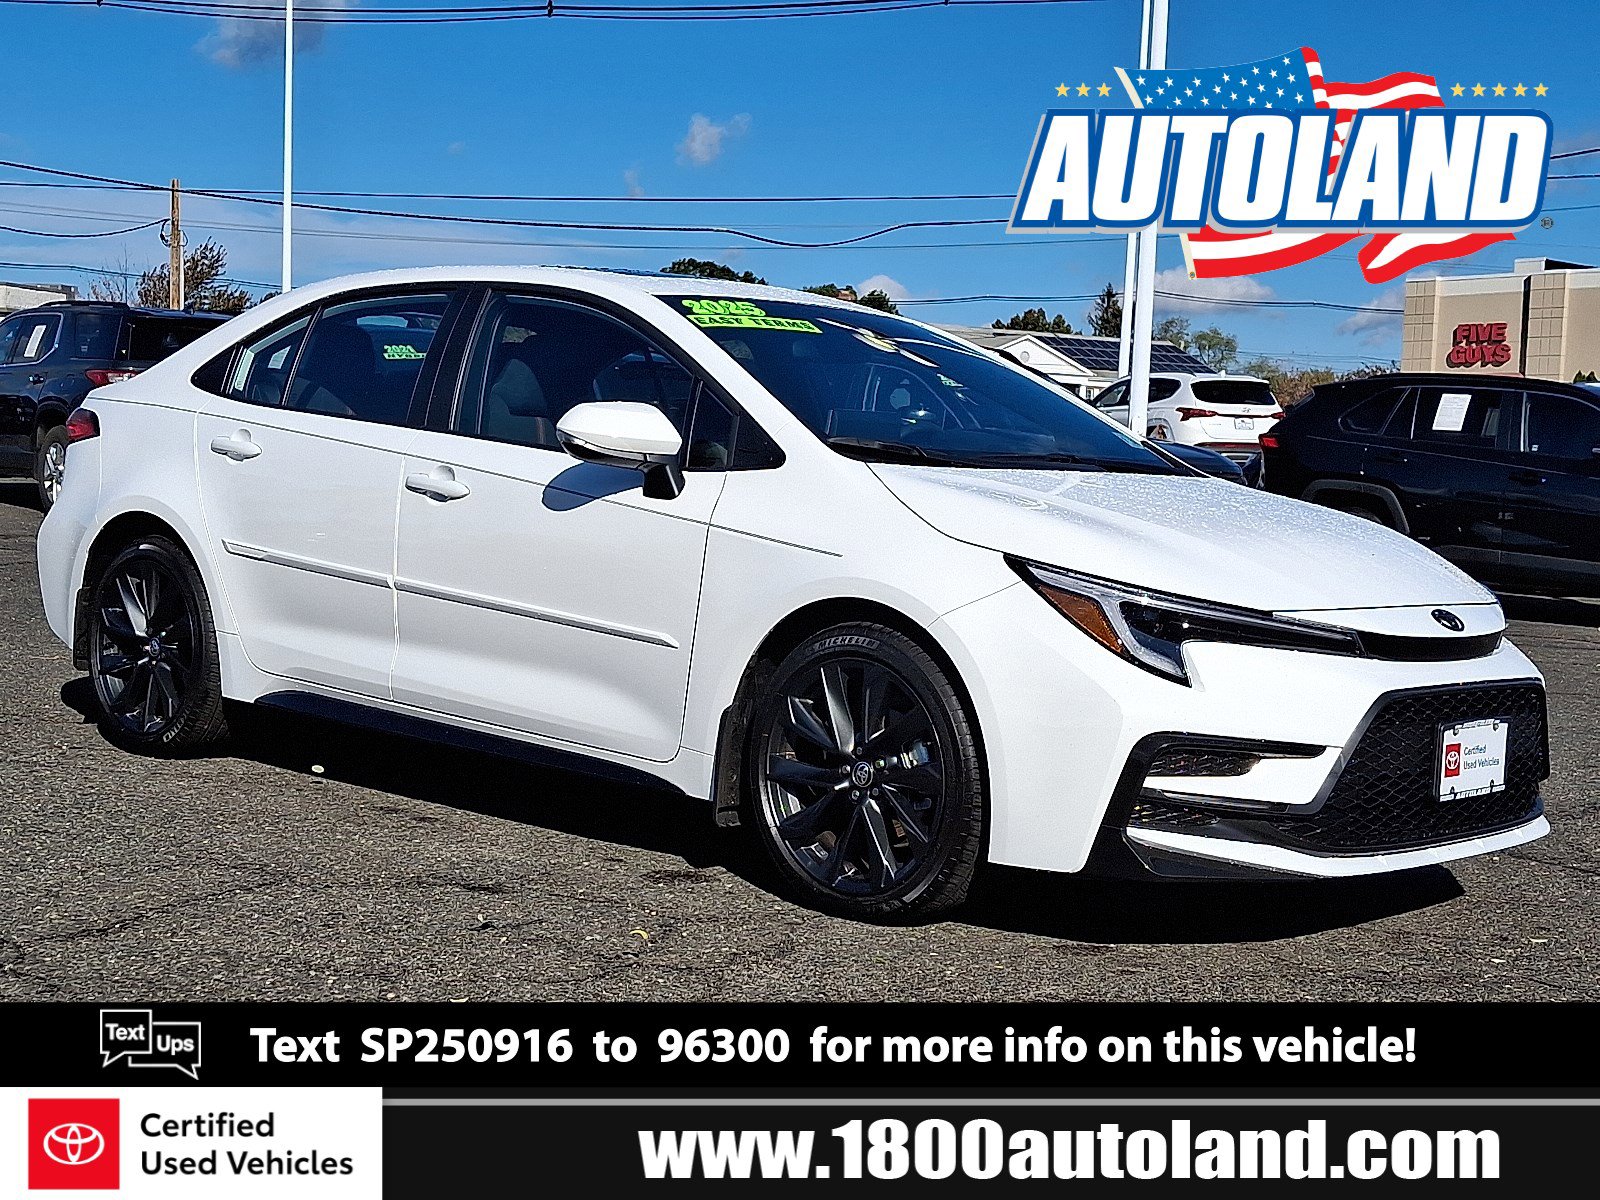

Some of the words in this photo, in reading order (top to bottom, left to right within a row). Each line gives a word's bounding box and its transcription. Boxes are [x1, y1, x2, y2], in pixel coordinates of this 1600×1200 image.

[682, 300, 766, 316] 2025
[694, 316, 744, 325] EASY
[747, 317, 817, 332] TERMS
[1455, 322, 1507, 343] FIVE
[1448, 344, 1511, 366] GUYS
[818, 636, 877, 649] MICHELIN
[1463, 744, 1487, 756] Certified
[1463, 760, 1477, 770] Used
[1477, 757, 1500, 768] Vehicles
